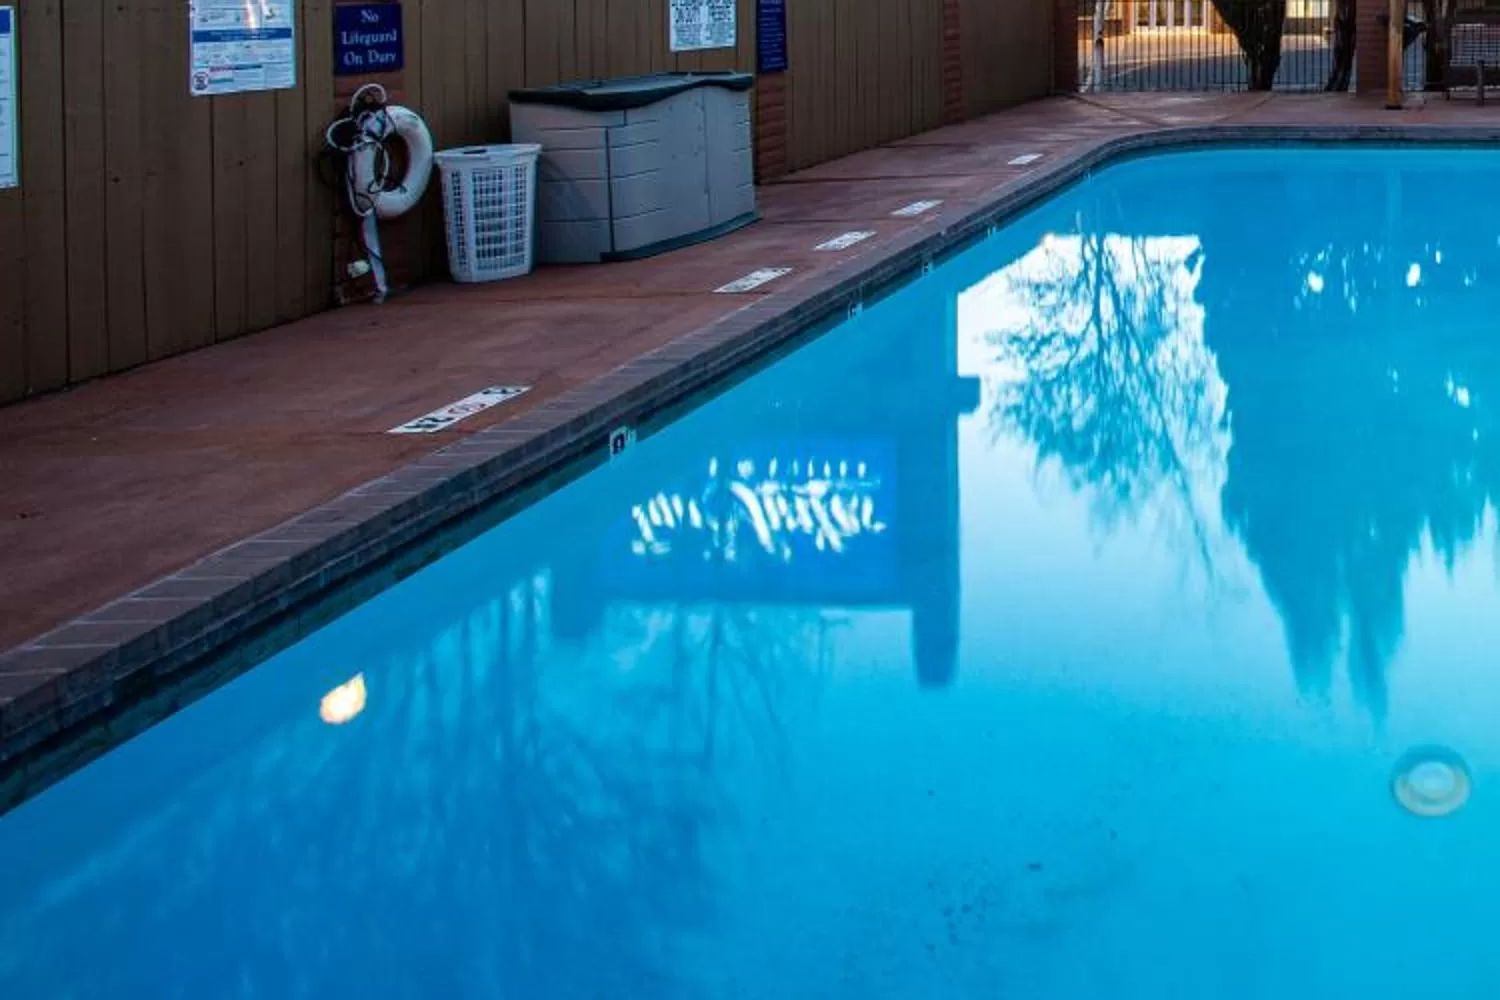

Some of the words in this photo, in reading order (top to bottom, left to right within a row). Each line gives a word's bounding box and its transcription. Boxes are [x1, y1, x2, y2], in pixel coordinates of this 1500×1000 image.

[360, 8, 379, 24] No
[341, 28, 397, 47] Lifeguard
[343, 51, 364, 66] On
[367, 48, 397, 66] Duty
